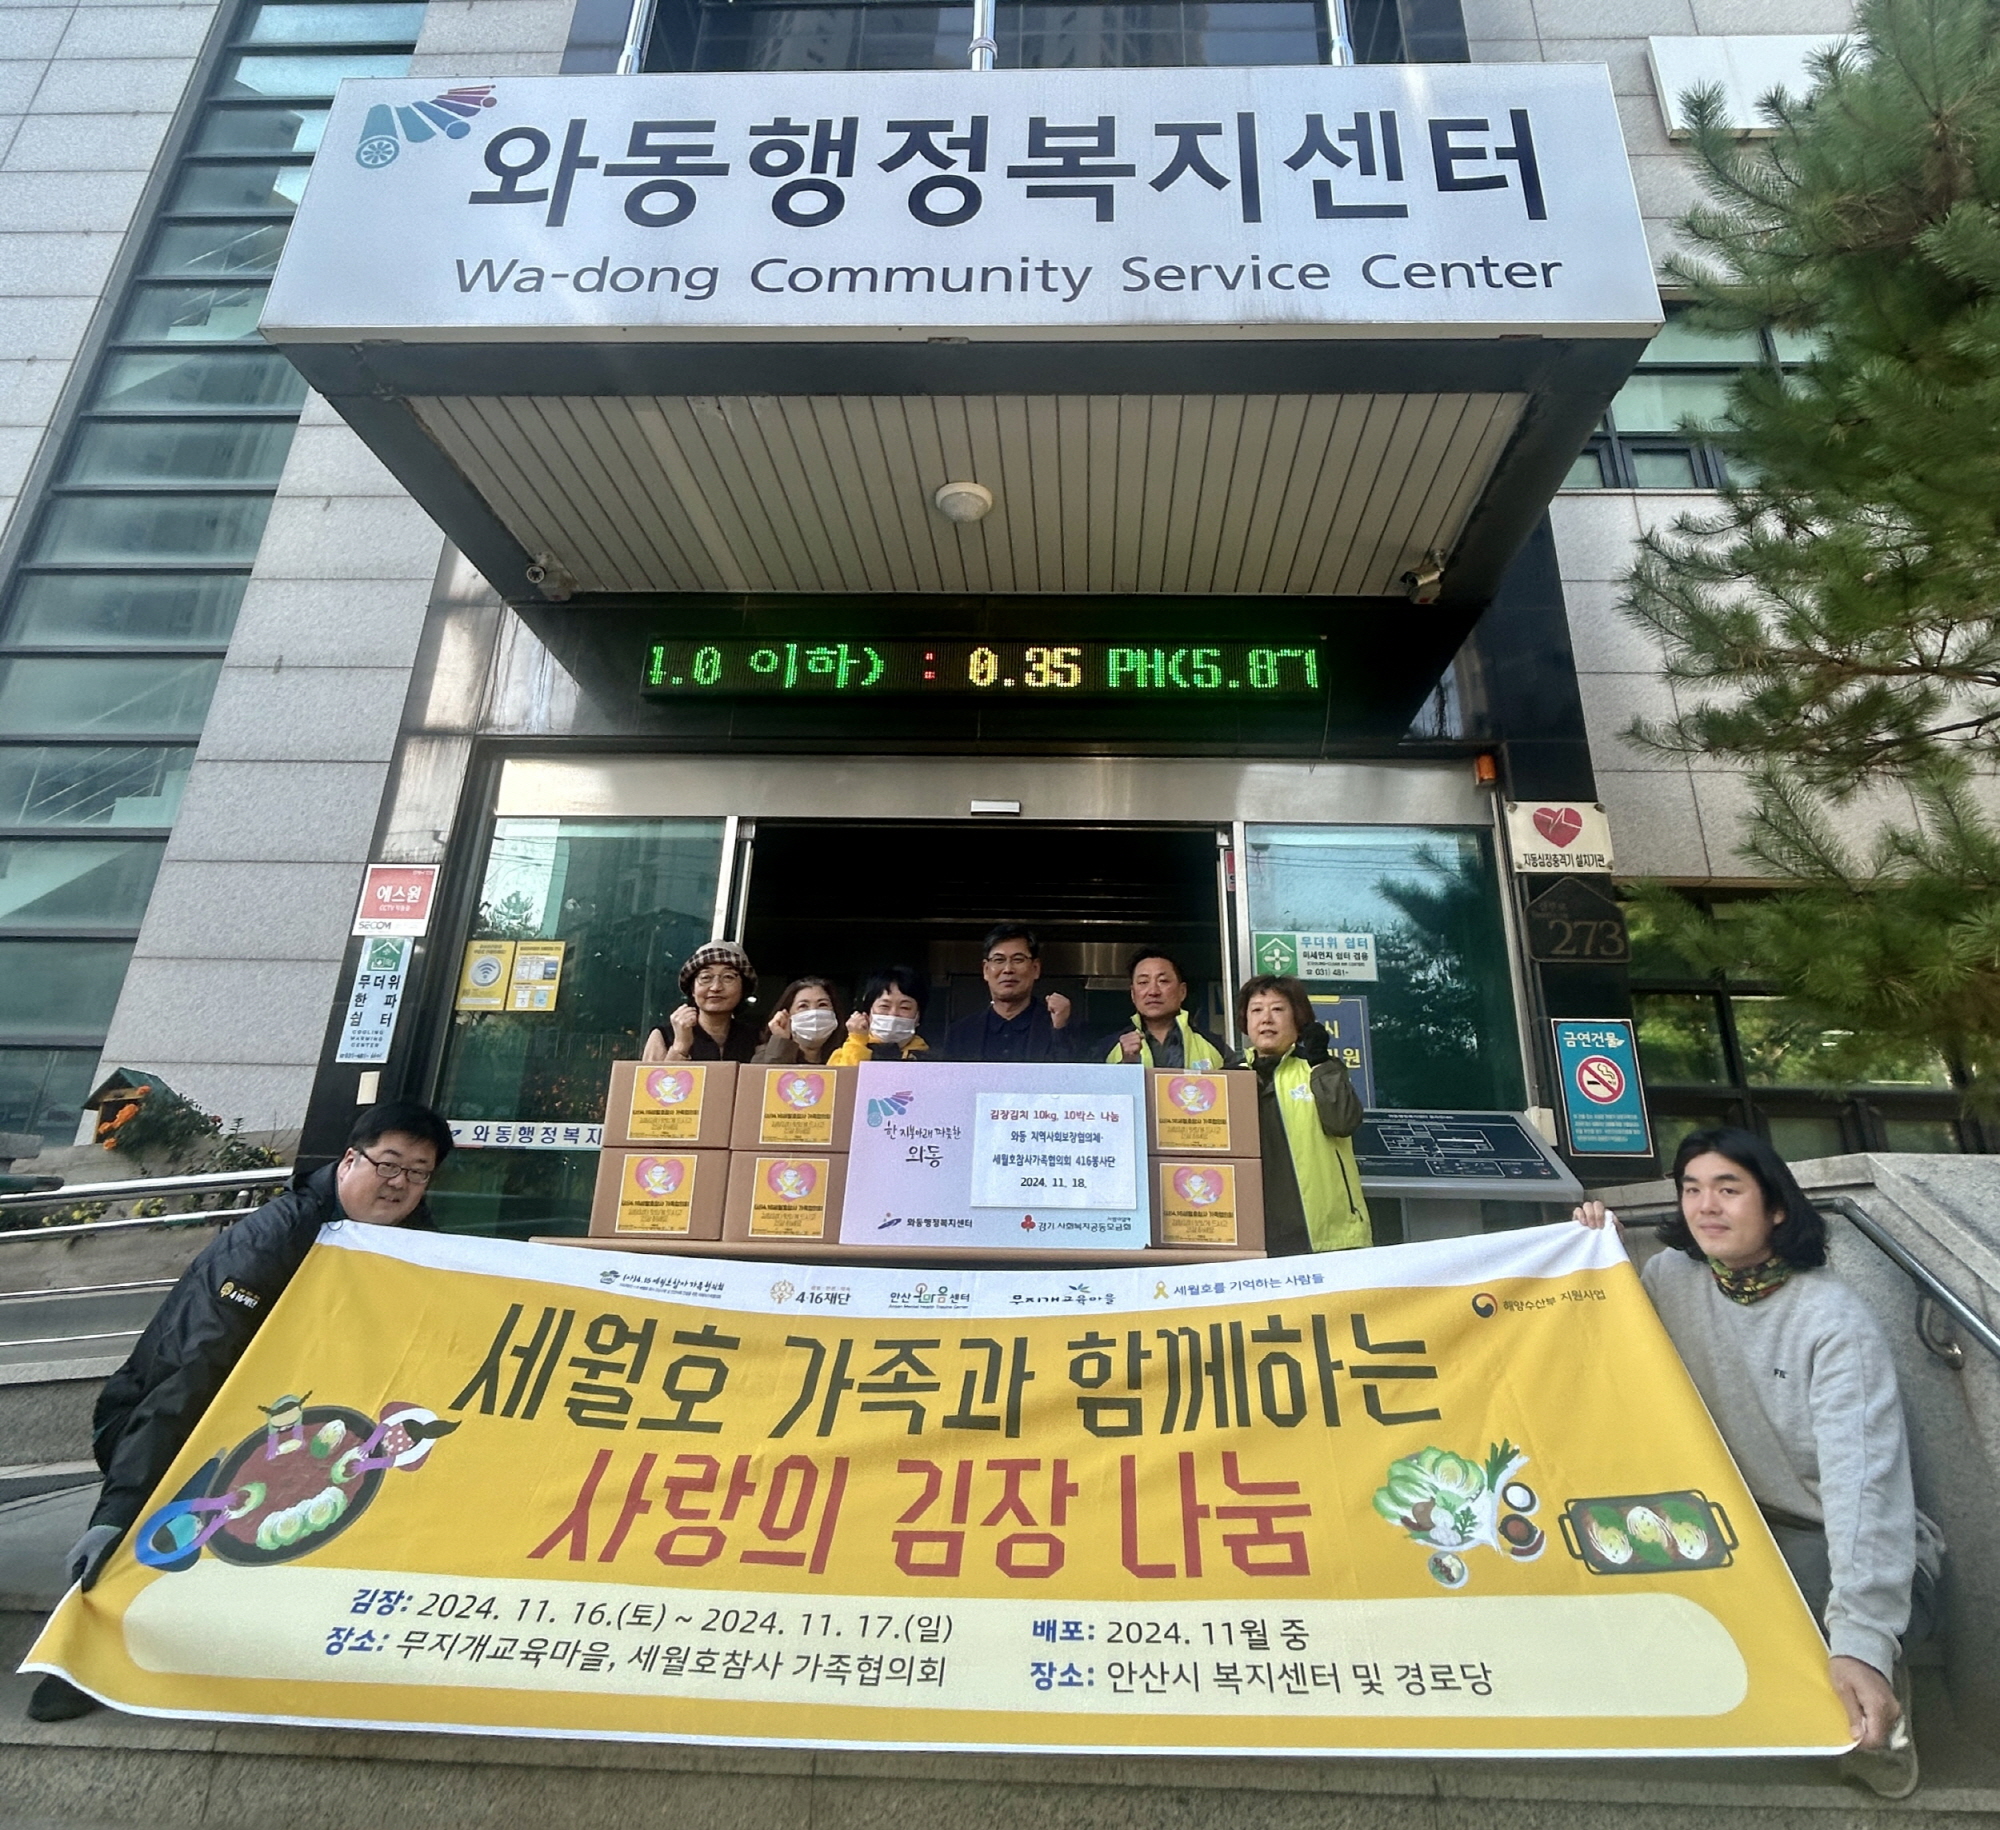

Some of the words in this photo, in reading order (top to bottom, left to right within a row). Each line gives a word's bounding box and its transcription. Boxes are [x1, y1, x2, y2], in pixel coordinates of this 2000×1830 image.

[468, 109, 1547, 228] 와동행정복지센터
[455, 256, 719, 301] Wa-dong
[750, 256, 1092, 302] Community
[1123, 254, 1330, 293] Service
[1362, 253, 1562, 289] Center
[750, 643, 884, 689] 이하)
[969, 647, 1081, 687] 0.35
[1522, 853, 1574, 868] 자동심장충격기
[1576, 853, 1606, 868] 설치기관
[376, 885, 422, 903] 에스원
[358, 921, 392, 930] SECOM
[1301, 936, 1338, 949] 무더위
[1344, 936, 1368, 949] 쉼터
[1549, 919, 1625, 955] 273
[1302, 951, 1333, 959] 미세먼지
[1336, 951, 1350, 960] 쉼터
[358, 974, 401, 990] 무더위
[350, 1011, 393, 1028] 쉼터
[1563, 1031, 1619, 1048] 금연건물
[990, 1109, 1029, 1120] 김장김치
[1064, 1110, 1095, 1121] 10박스
[1101, 1111, 1119, 1122] 나눔
[472, 1125, 603, 1146] 와동행정복지
[1010, 1131, 1027, 1143] 와동
[905, 1145, 944, 1168] 와동
[992, 1154, 1071, 1167] 세월호참사가족협의회
[1075, 1155, 1116, 1168] 416봉사단
[1020, 1177, 1047, 1187] 2024.
[1052, 1178, 1067, 1188] 11.
[1072, 1178, 1087, 1188] 18.
[906, 1218, 973, 1228] 와동행정복지센터
[1038, 1222, 1055, 1231] 경기
[1058, 1222, 1132, 1232] 사회복지공동모금회
[1174, 1281, 1226, 1296] 세월호를
[1229, 1277, 1282, 1292] 기억하는
[1285, 1273, 1325, 1286] 사람들
[1503, 1297, 1557, 1311] 해양수산부
[1560, 1289, 1607, 1302] 지원사업
[448, 1303, 740, 1434] 세월호
[768, 1335, 1035, 1439] 가족과
[1067, 1313, 1442, 1438] 함께하는
[526, 1448, 850, 1575] 사랑의
[891, 1458, 1078, 1578] 김장
[1120, 1450, 1313, 1578] 나눔
[350, 1587, 414, 1617] 김장:
[416, 1592, 500, 1621] 2024.
[518, 1598, 556, 1623] 11.
[572, 1600, 668, 1632] 16.(토)
[699, 1608, 785, 1636] 2024.
[800, 1612, 843, 1638] 11.
[857, 1612, 953, 1644] 17.(일)
[1032, 1618, 1095, 1644] 배포:
[1106, 1621, 1191, 1645] 2024.
[1201, 1618, 1270, 1651] 11월
[1280, 1618, 1310, 1650] 중
[325, 1626, 388, 1656] 장소:
[396, 1629, 617, 1674] 무지개교육마을,
[627, 1643, 784, 1682] 세월호참사
[791, 1652, 946, 1688] 가족협의회
[1030, 1661, 1095, 1691] 장소:
[1106, 1660, 1200, 1694] 안산시
[1212, 1660, 1341, 1696] 복지센터
[1352, 1662, 1386, 1696] 및
[1396, 1660, 1494, 1697] 경로당
